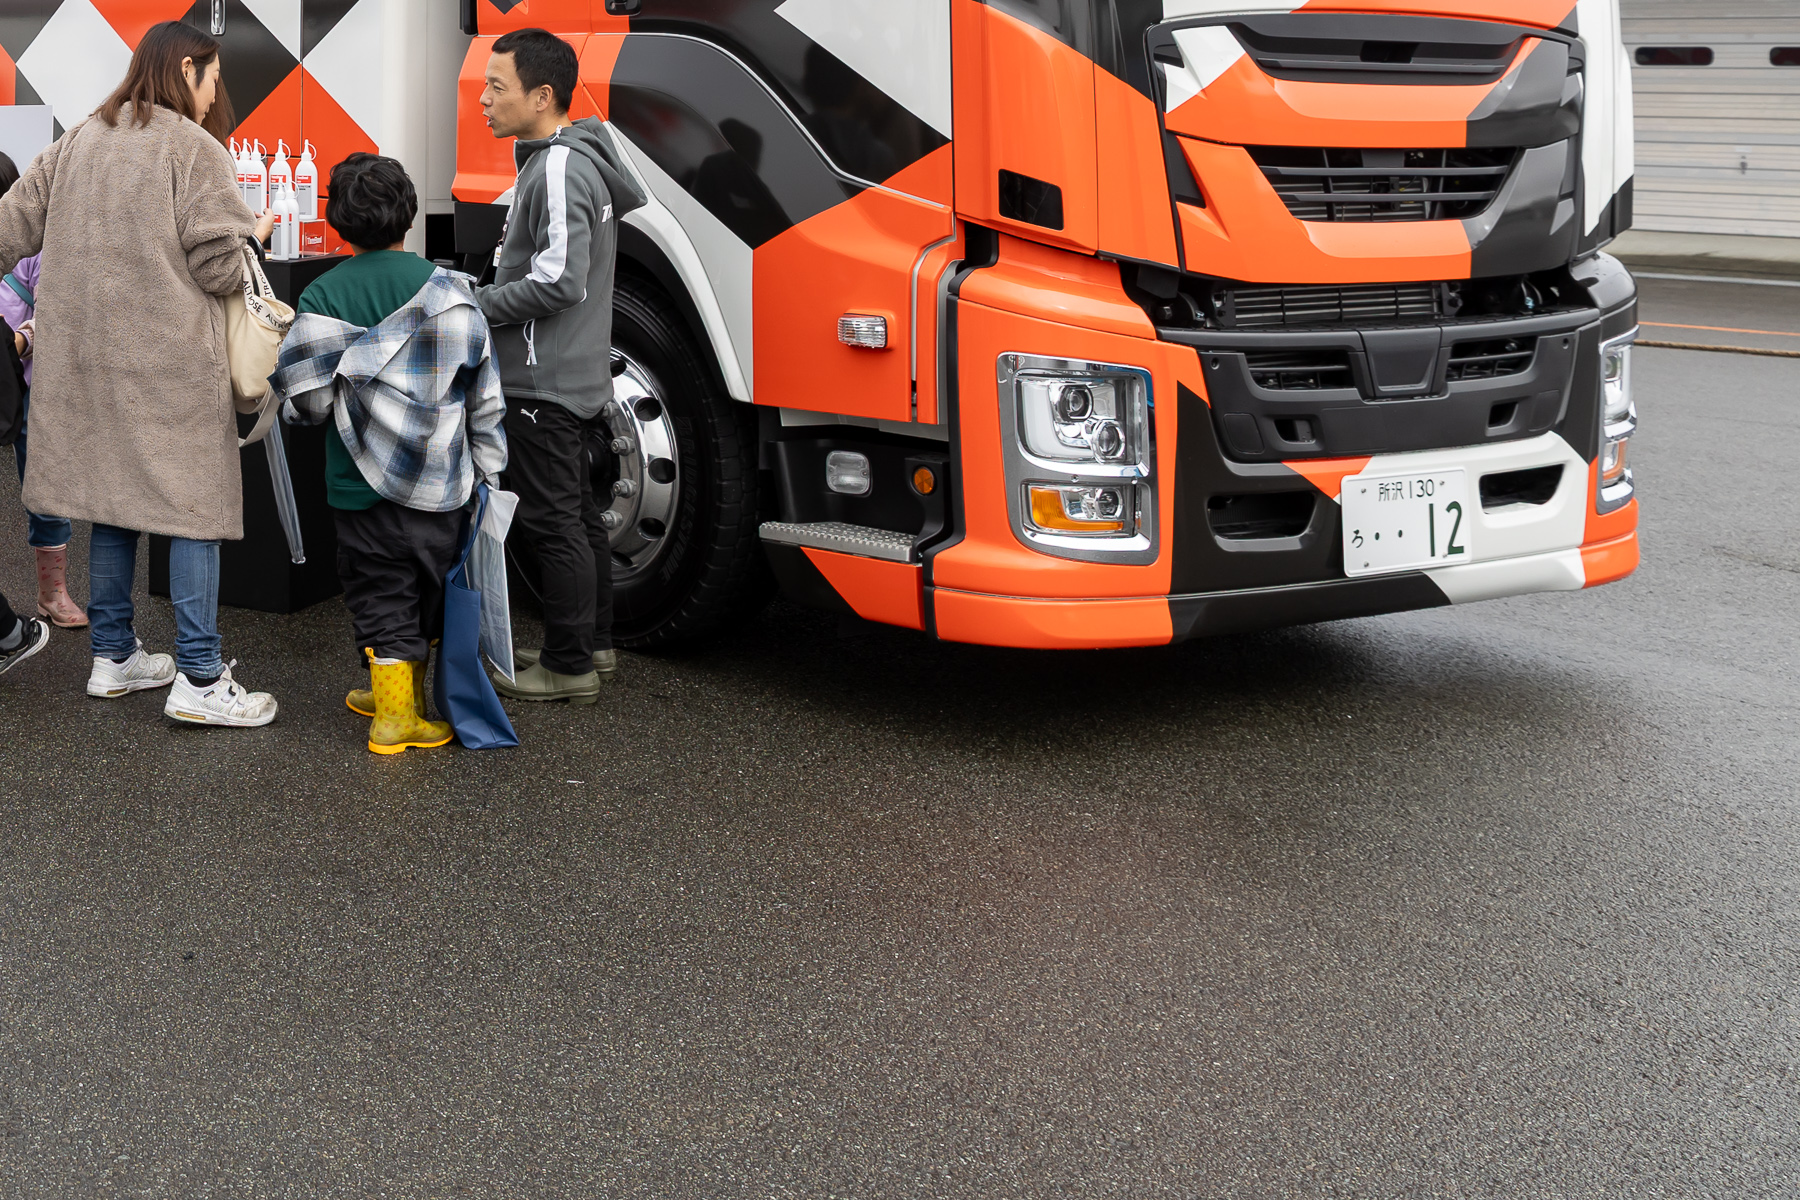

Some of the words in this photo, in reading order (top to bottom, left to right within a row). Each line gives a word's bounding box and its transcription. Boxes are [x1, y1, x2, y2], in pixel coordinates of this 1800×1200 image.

[1378, 482, 1405, 502] 所沢
[1408, 479, 1435, 499] 130
[1351, 529, 1364, 548] ろ
